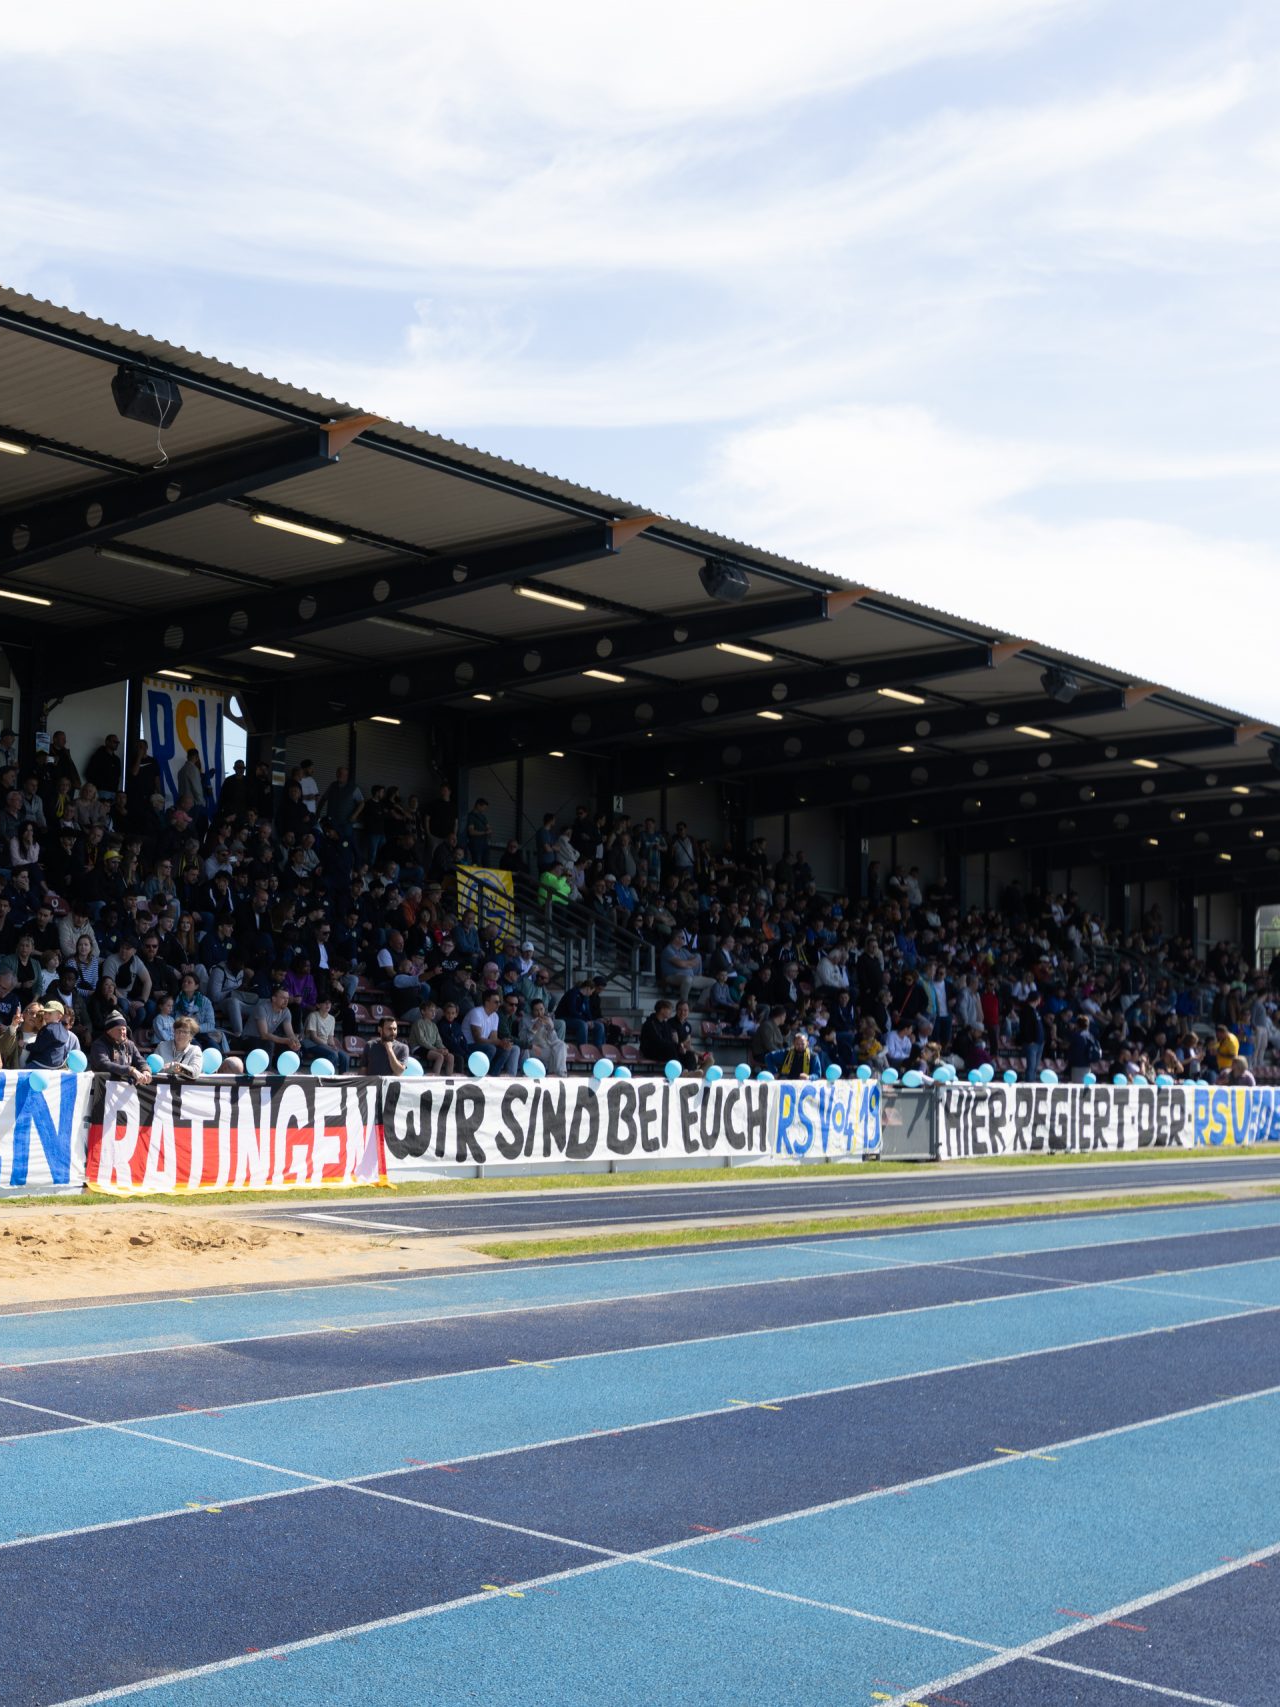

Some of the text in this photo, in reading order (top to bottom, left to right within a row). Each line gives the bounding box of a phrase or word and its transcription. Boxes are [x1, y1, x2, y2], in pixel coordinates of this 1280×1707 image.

[97, 1080, 380, 1189] RATINGEN
[679, 1083, 768, 1154] EUCH
[945, 1087, 1251, 1158] HIER REGIERT DER RSV
